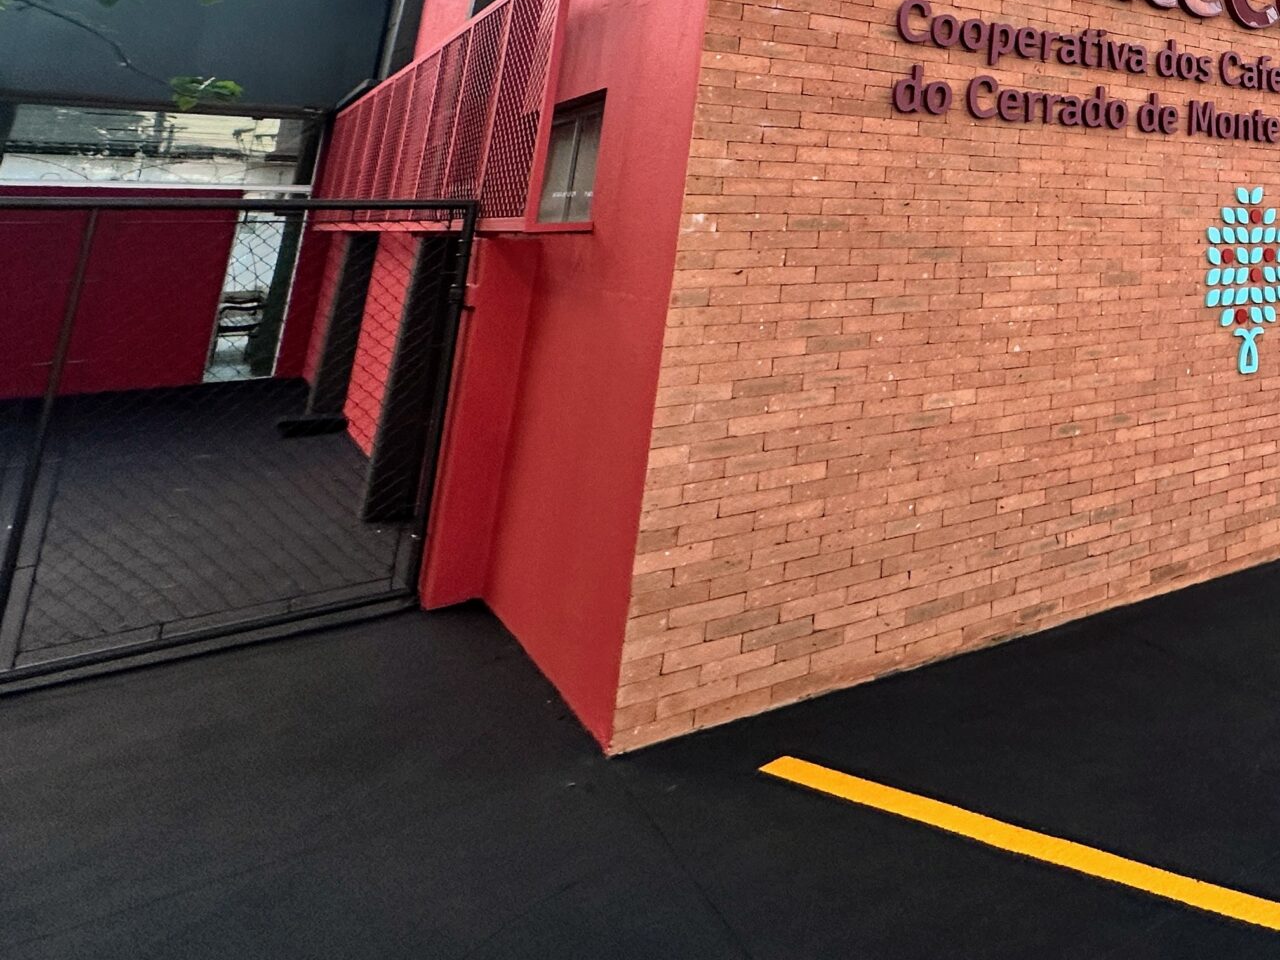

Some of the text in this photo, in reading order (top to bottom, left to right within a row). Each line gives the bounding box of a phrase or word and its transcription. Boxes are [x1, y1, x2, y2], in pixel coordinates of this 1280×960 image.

[1157, 39, 1213, 83] dos
[894, 65, 953, 115] do
[967, 75, 1128, 130] Cerrado
[1138, 93, 1179, 135] de
[1188, 99, 1280, 143] Monte
